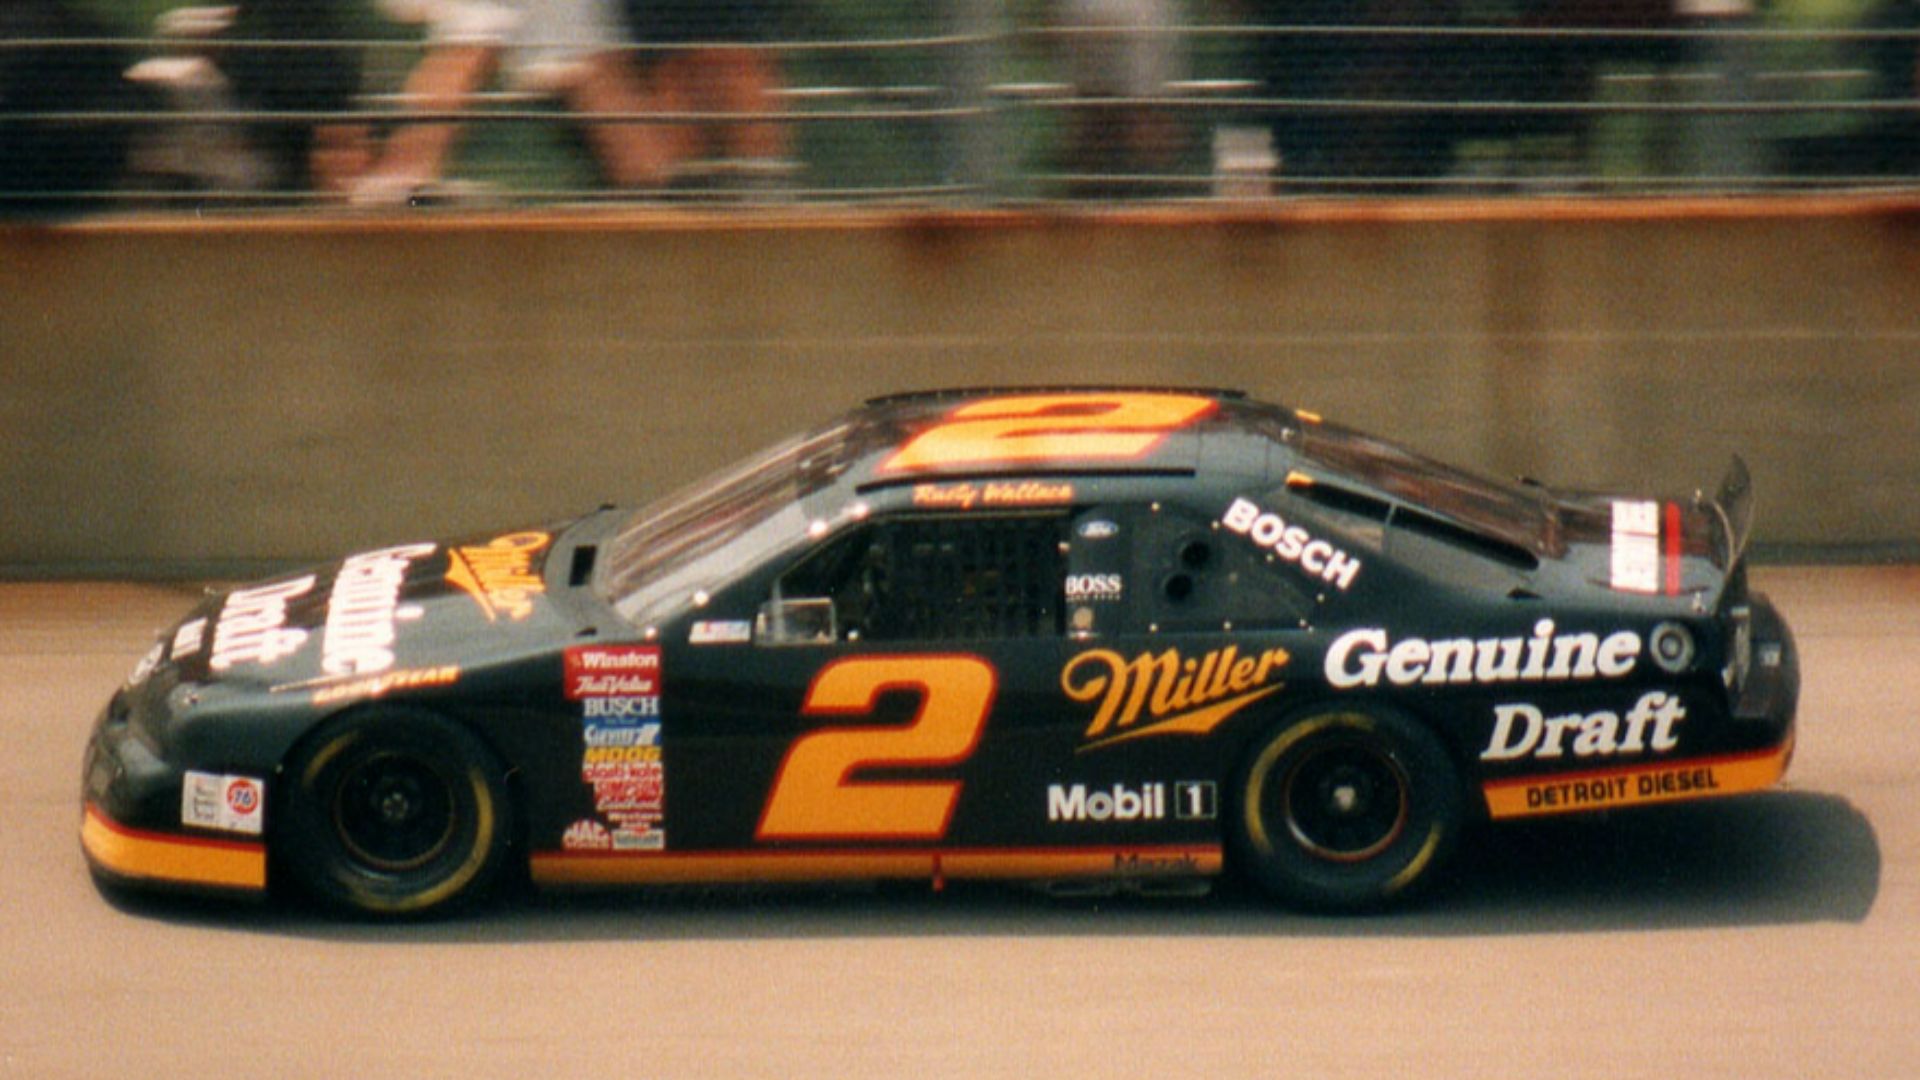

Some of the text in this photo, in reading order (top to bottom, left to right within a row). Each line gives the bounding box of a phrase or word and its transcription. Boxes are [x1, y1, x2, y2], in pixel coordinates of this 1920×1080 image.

[873, 390, 1221, 473] 2
[1221, 497, 1362, 590] BOSCH
[1065, 574, 1121, 594] BOSS
[582, 650, 658, 669] Winston
[1324, 618, 1642, 689] Genuine
[584, 695, 659, 717] BUSCH
[1061, 644, 1290, 736] Miller
[755, 652, 997, 842] 2
[1480, 691, 1687, 761] Draft
[1047, 782, 1165, 821] Mobil
[1526, 766, 1720, 809] DETROIT DIESEL
